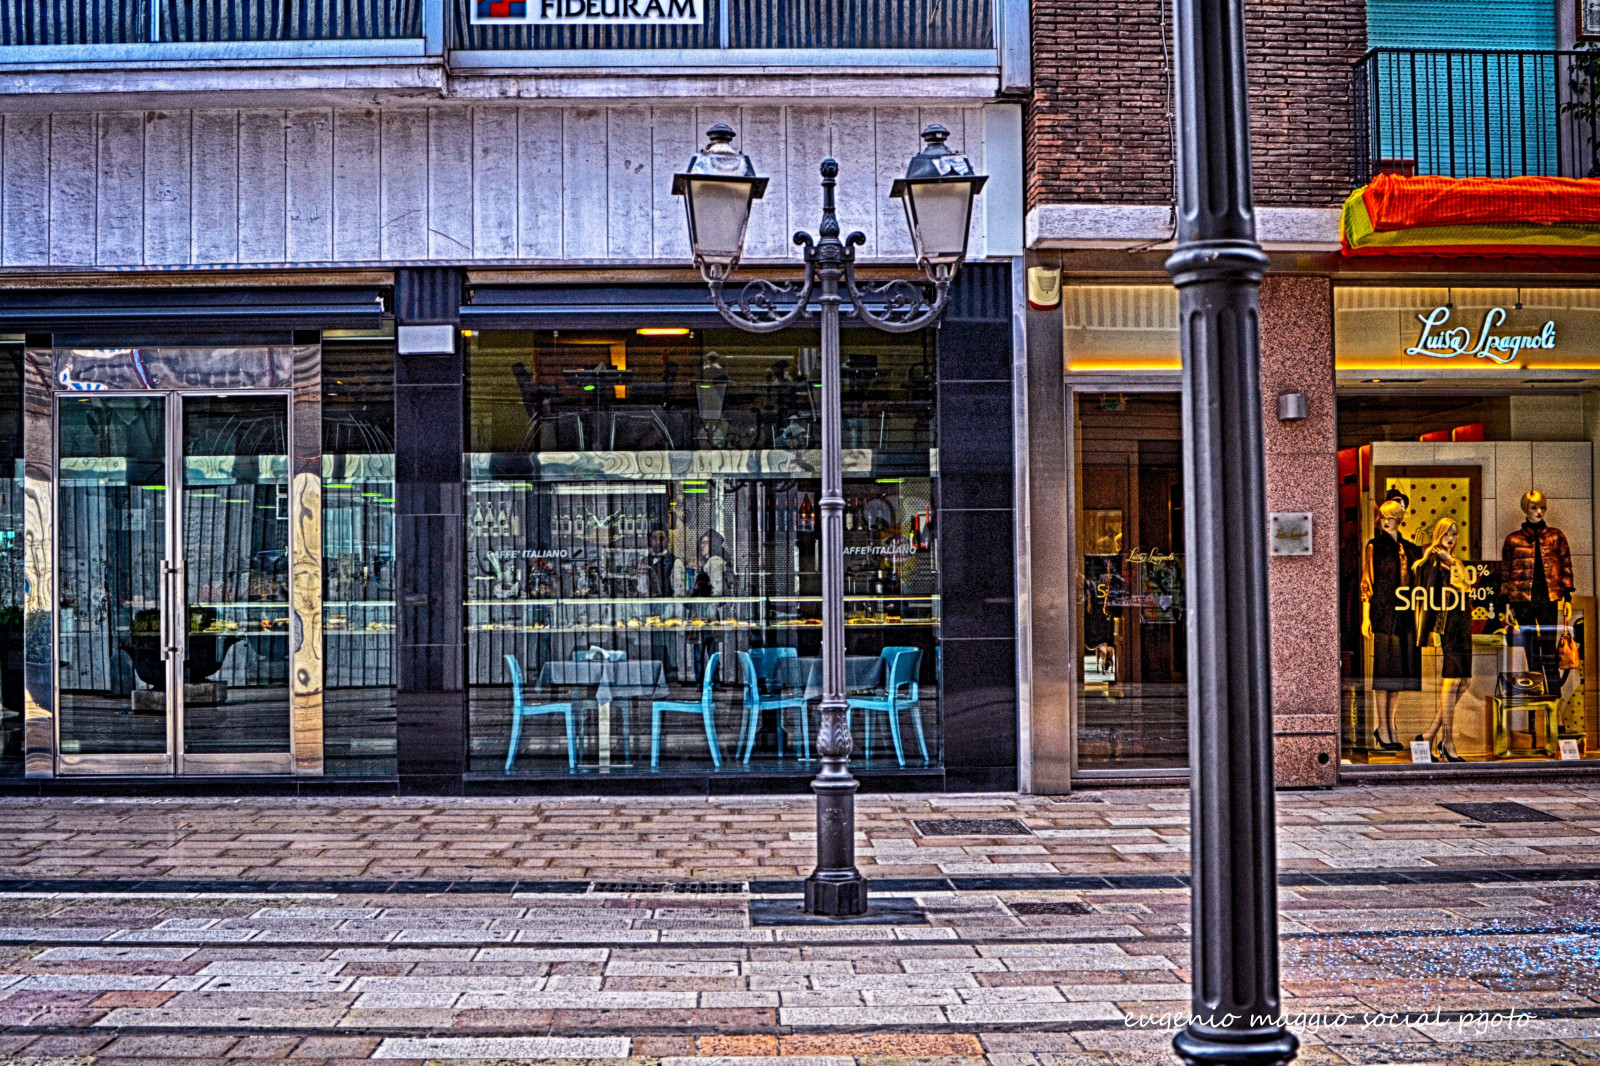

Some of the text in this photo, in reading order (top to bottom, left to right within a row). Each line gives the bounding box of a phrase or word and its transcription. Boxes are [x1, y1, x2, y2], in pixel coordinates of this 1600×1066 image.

[541, 0, 697, 18] FIDEURAM
[1406, 306, 1556, 363] Luisa Spagnoli
[522, 549, 568, 558] ITALIANO
[872, 546, 917, 555] ITALIANO
[1394, 586, 1466, 612] SALDI
[1468, 586, 1495, 601] 40%
